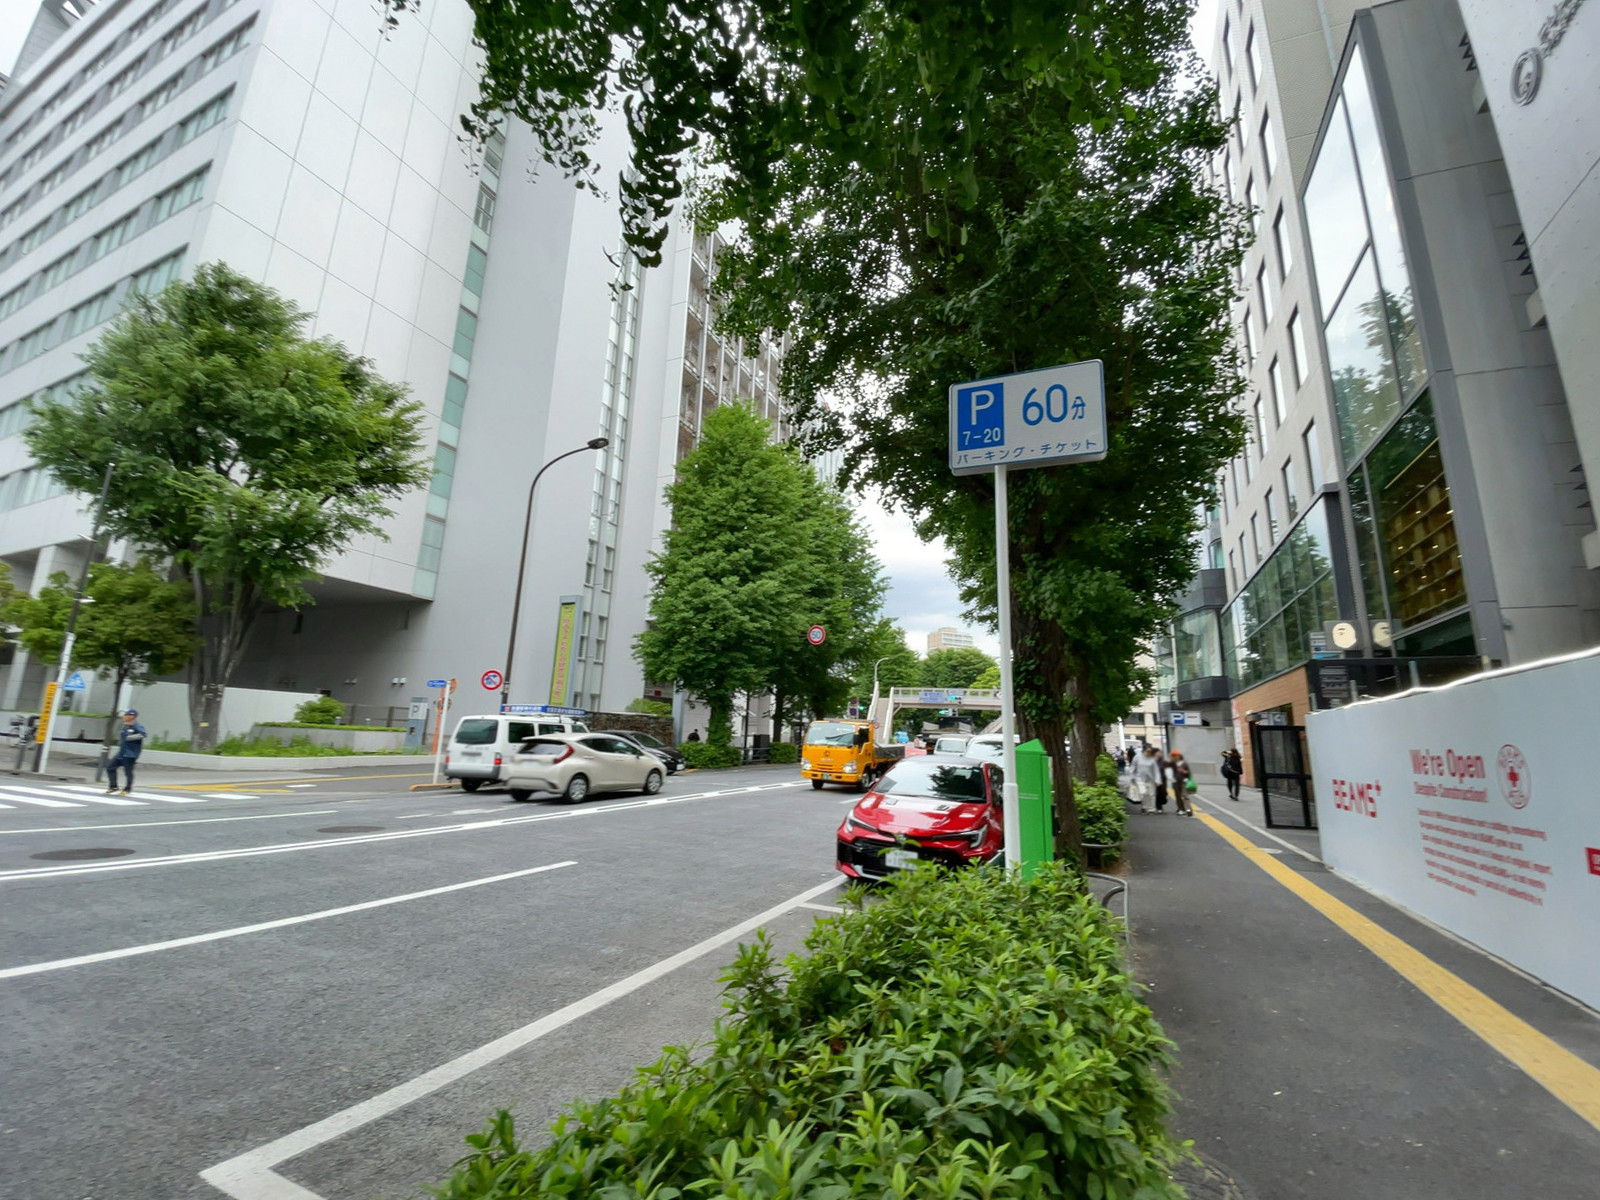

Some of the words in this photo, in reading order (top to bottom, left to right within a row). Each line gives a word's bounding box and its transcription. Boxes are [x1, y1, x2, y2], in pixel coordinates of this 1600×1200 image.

[970, 390, 995, 426] P
[957, 439, 1097, 464] パーキング・チケット
[962, 427, 1002, 446] 7-20
[1409, 748, 1445, 776] We're
[1446, 748, 1486, 784] Open
